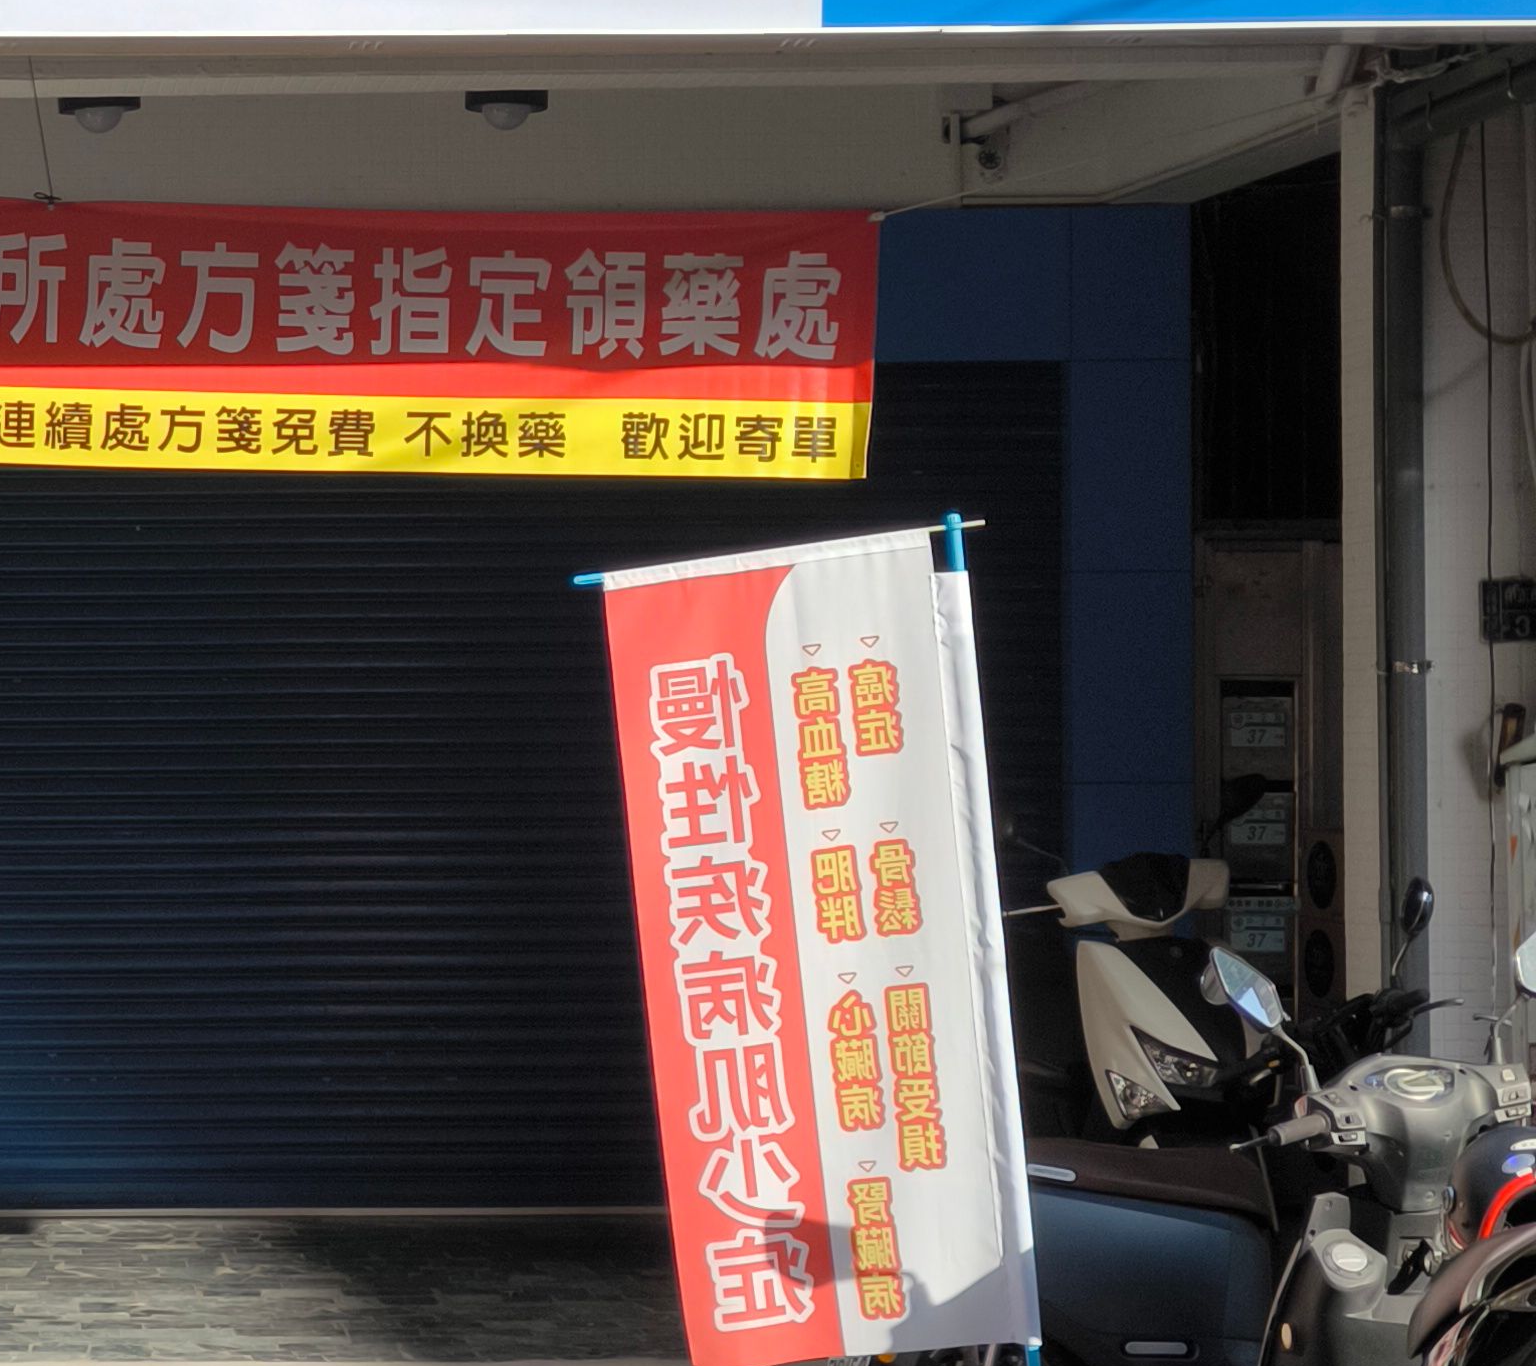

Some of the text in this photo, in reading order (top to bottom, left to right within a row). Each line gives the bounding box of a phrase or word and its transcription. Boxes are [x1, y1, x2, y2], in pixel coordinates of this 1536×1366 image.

[403, 410, 568, 459] 不換藥
[620, 412, 838, 464] 歡迎寄單
[1246, 728, 1267, 744] 37
[1246, 825, 1267, 841] 37
[1246, 932, 1267, 948] 37
